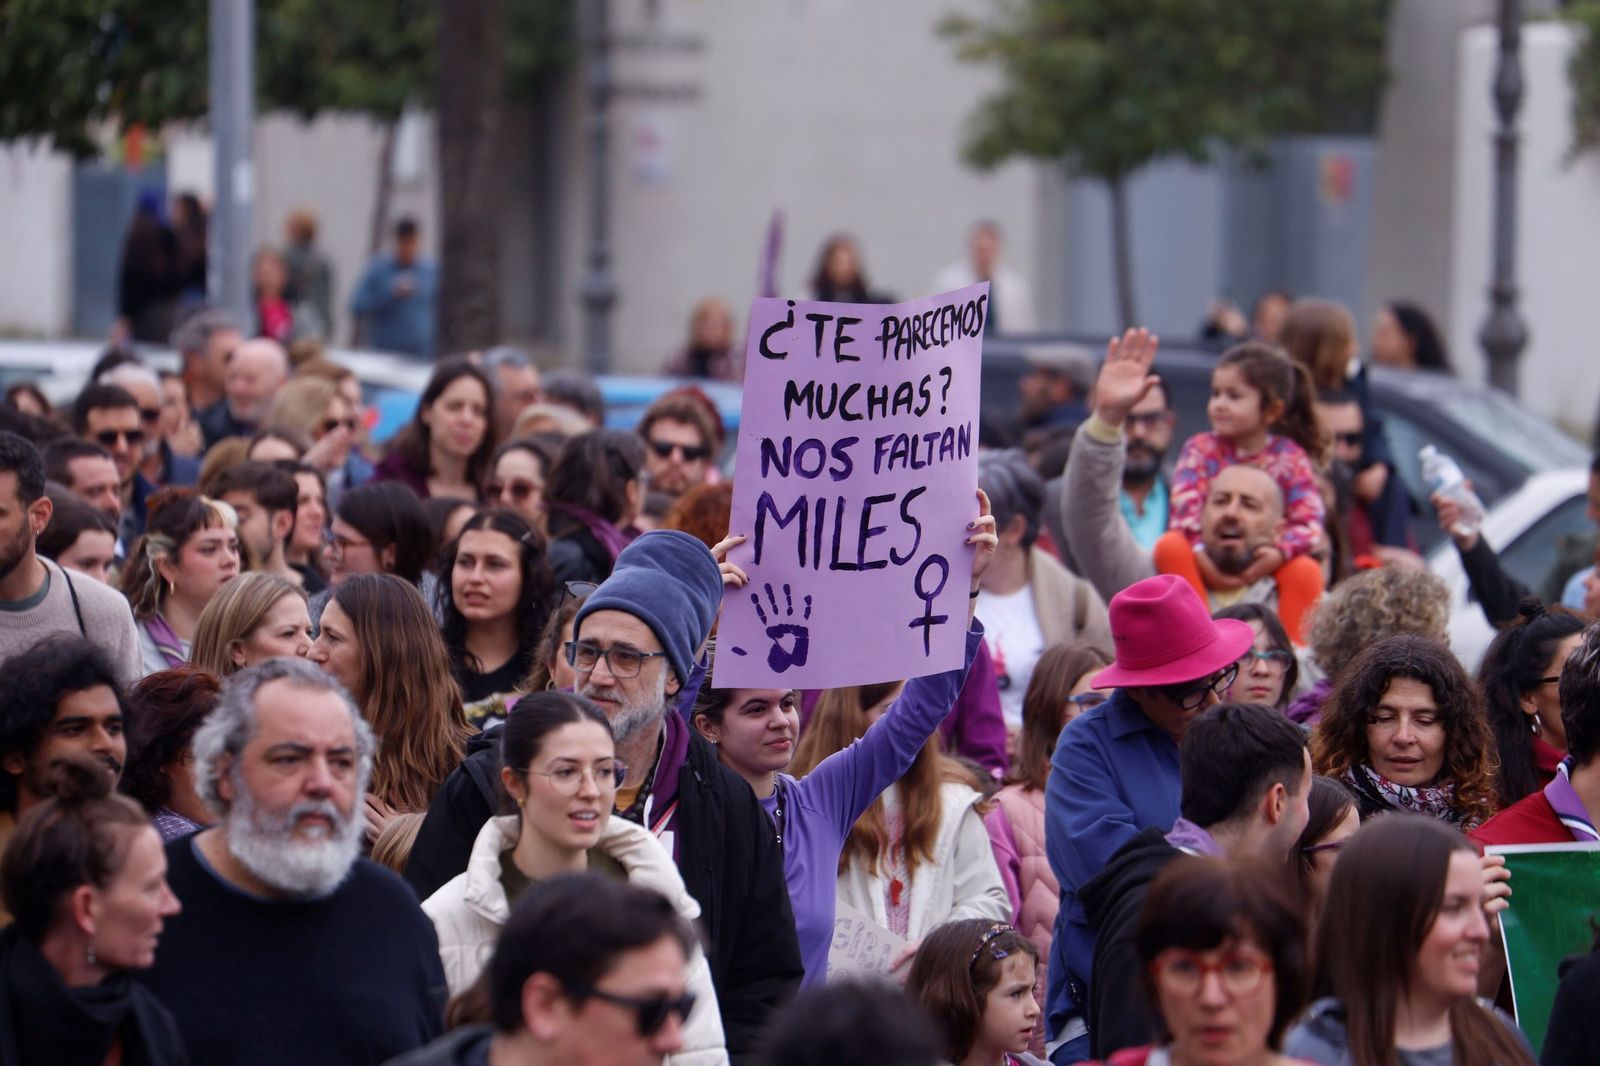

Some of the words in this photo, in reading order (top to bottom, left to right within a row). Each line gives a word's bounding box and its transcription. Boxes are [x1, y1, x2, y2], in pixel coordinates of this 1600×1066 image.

[758, 299, 863, 364] ¿TE
[875, 294, 987, 361] PARECEMOS
[783, 366, 952, 422] MUCHAS?
[760, 435, 860, 482] NOS
[873, 421, 971, 476] FALTAN
[752, 486, 926, 571] MILES
